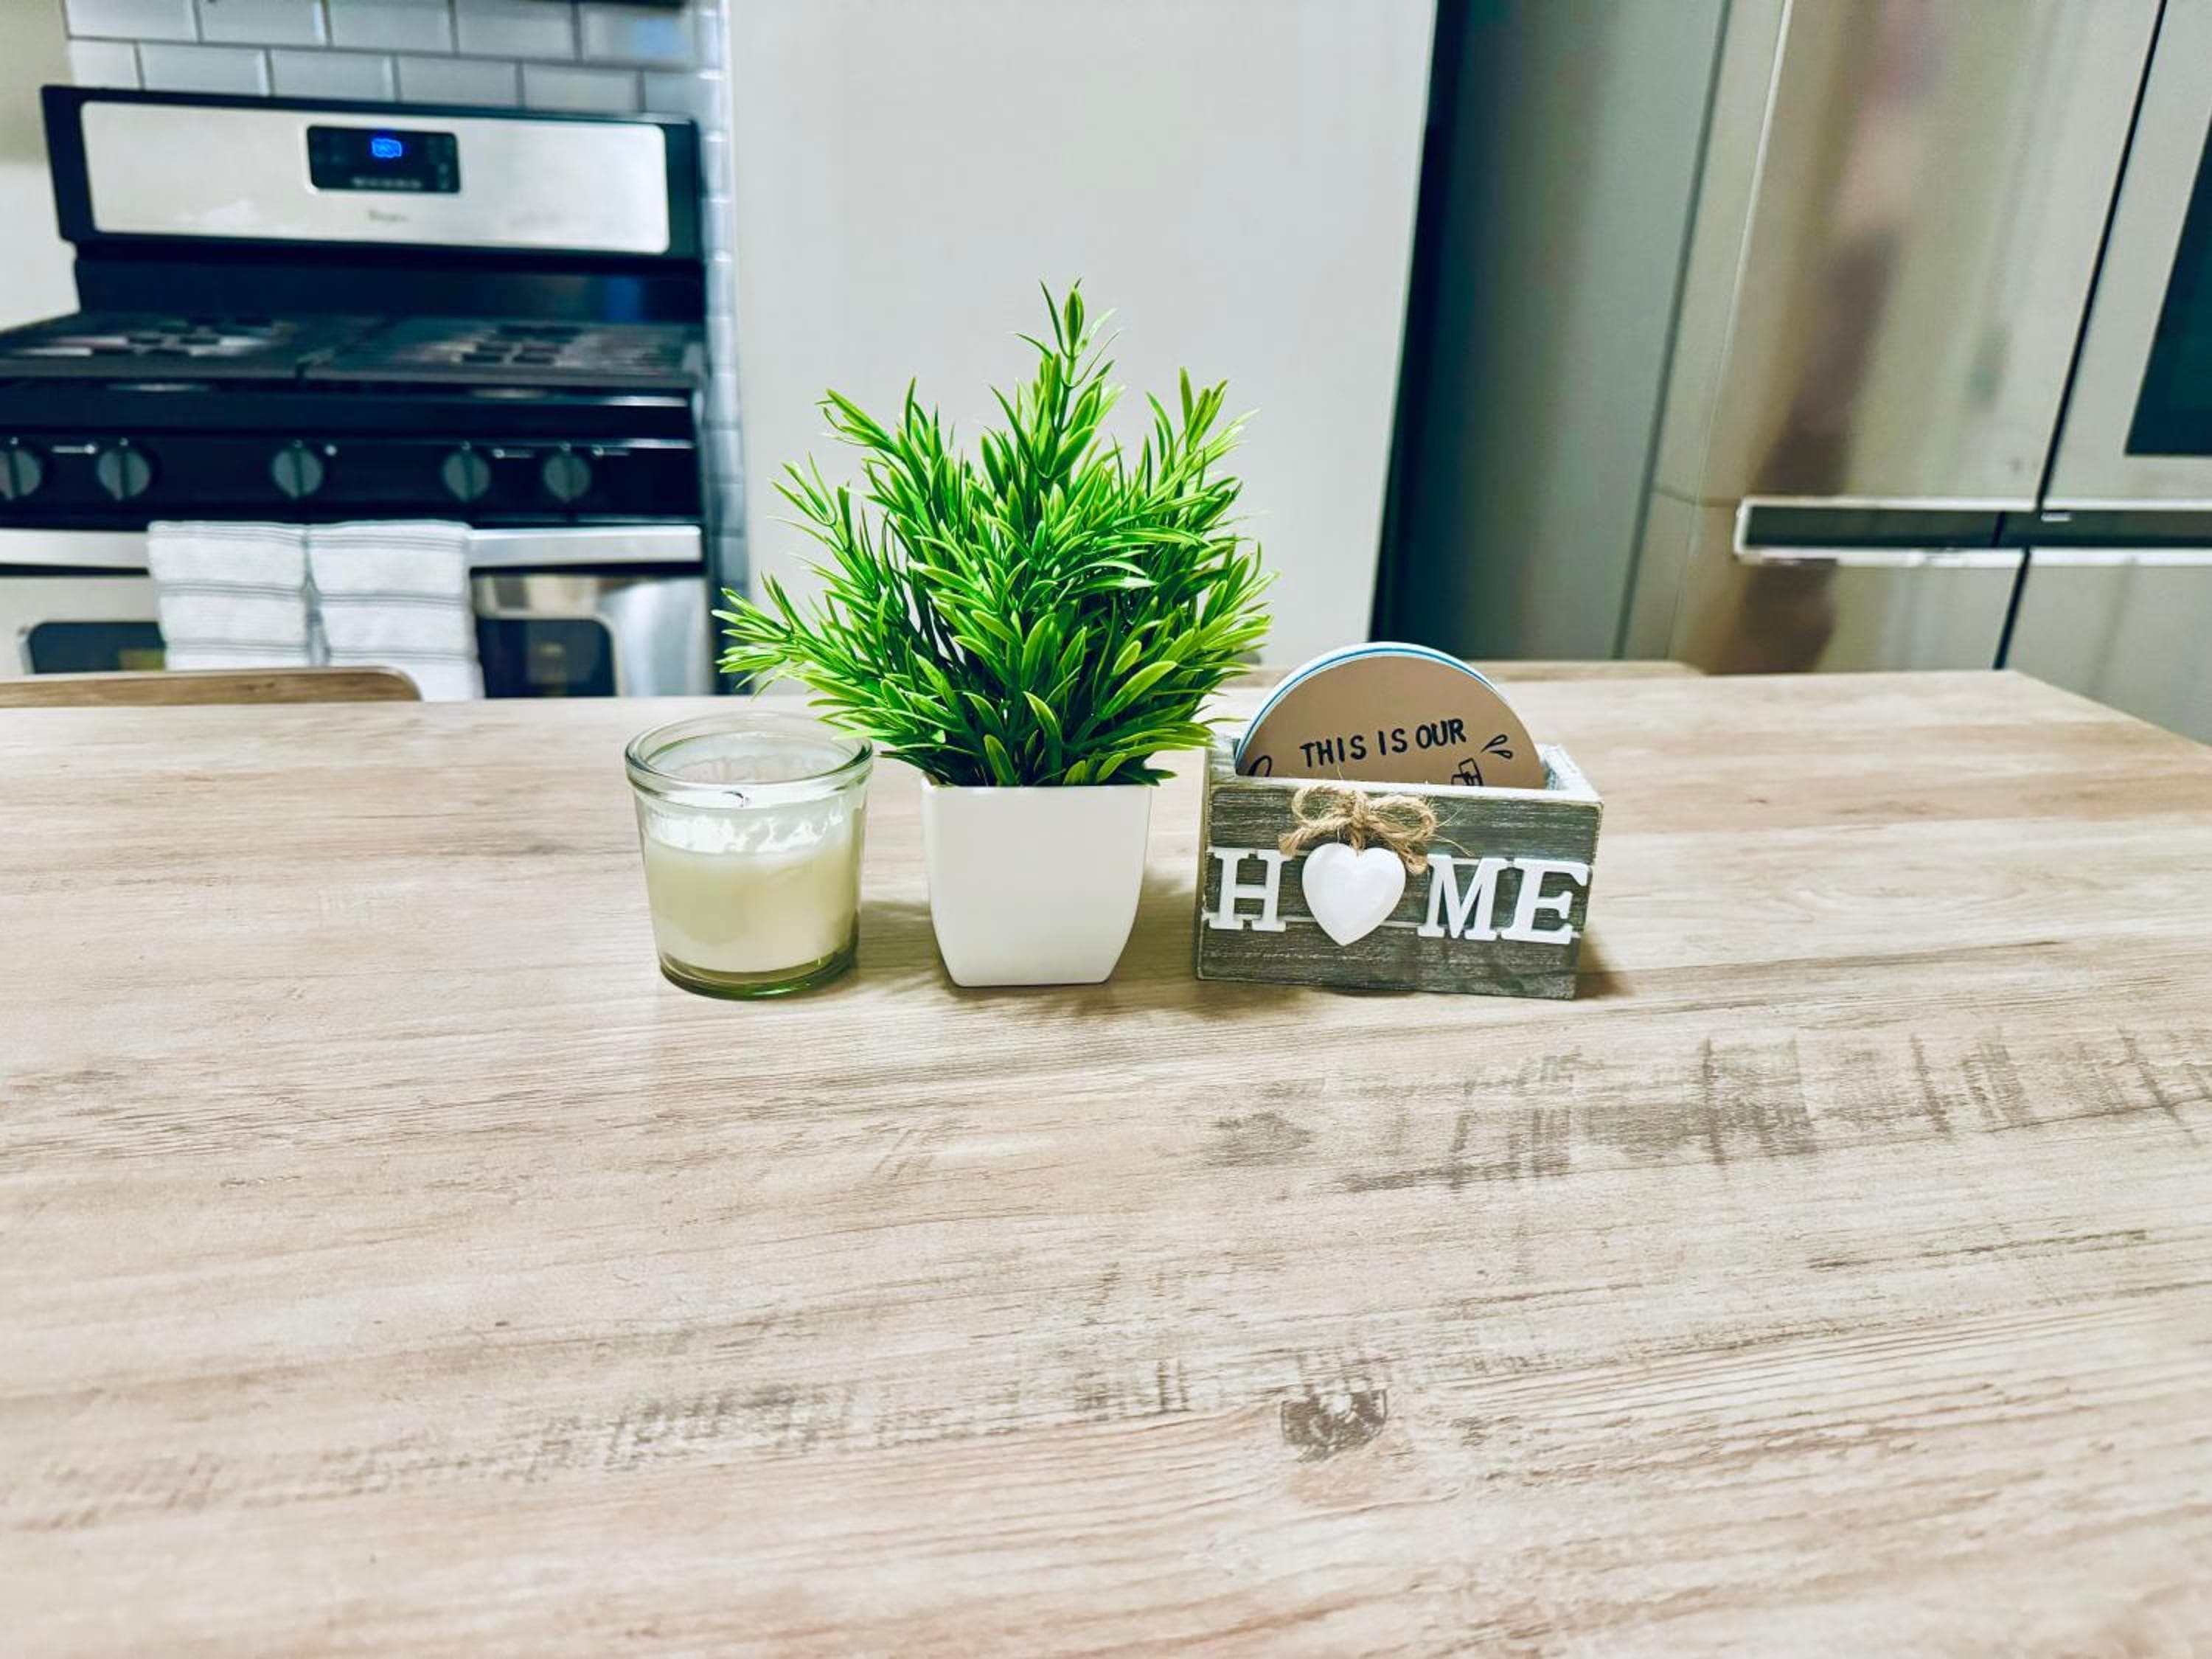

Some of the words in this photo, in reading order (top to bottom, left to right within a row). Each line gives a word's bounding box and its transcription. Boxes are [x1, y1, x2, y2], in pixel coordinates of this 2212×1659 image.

[1299, 734, 1368, 768] THIS
[1377, 728, 1408, 756] IS
[1415, 717, 1467, 749] OUR
